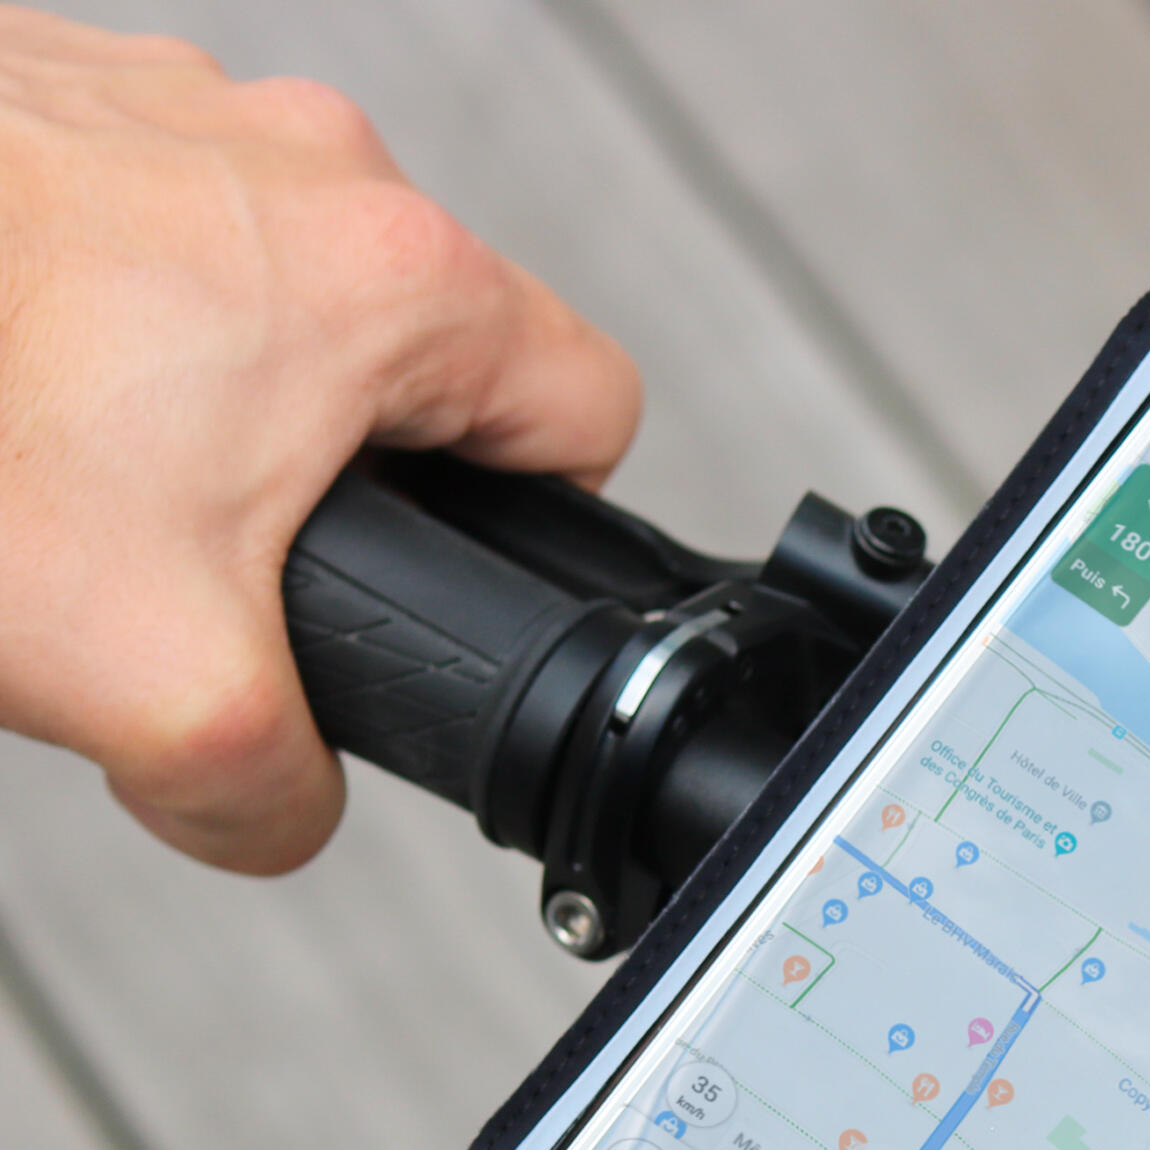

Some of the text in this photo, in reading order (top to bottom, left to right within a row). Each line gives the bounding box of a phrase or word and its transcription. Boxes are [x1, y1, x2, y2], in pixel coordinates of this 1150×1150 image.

[1070, 558, 1106, 589] Puis
[930, 739, 1058, 836] Office du Tourisme et
[1010, 749, 1088, 811] Hôtel de Ville
[919, 755, 1047, 850] des Congrès de Paris
[922, 905, 940, 926] Le
[691, 1075, 723, 1104] 35
[675, 1095, 706, 1121] km/h
